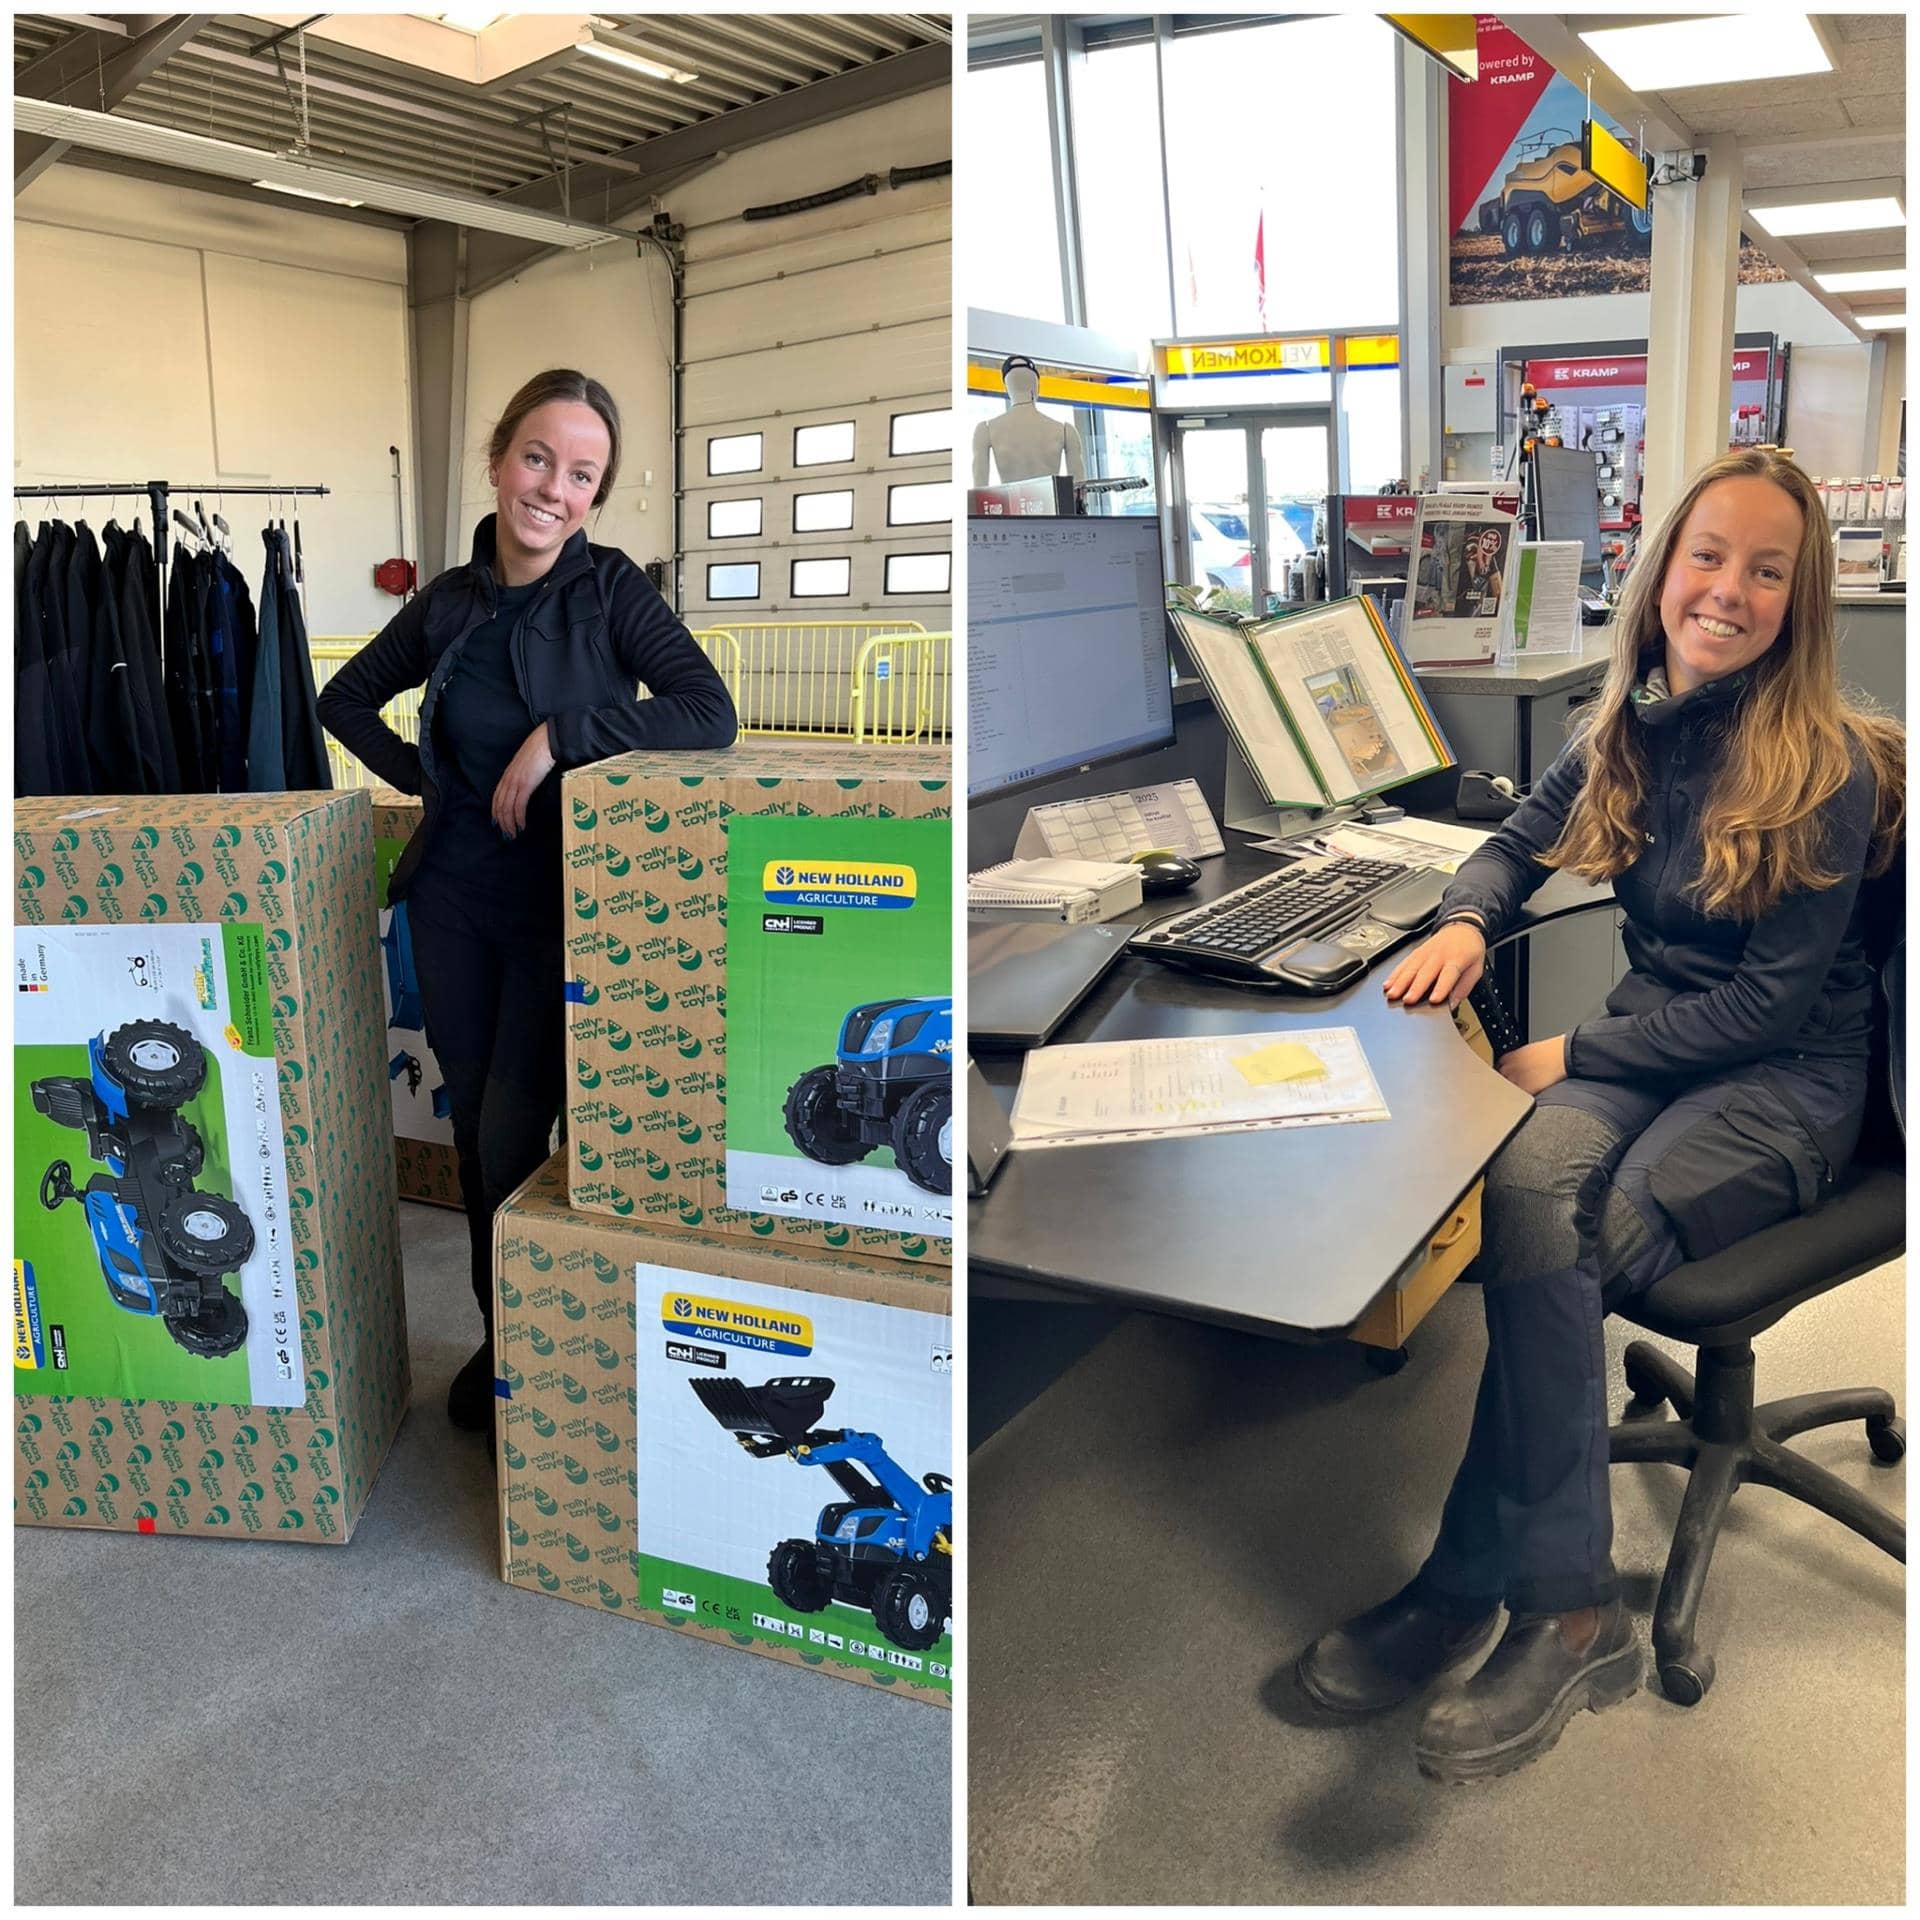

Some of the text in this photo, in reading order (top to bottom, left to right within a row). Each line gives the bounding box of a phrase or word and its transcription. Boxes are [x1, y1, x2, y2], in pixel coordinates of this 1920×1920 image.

[1479, 54, 1535, 71] owered by
[1490, 72, 1535, 85] KRAMP
[1573, 367, 1618, 378] KRAMP
[1136, 792, 1159, 803] 2025
[609, 809, 643, 825] toys
[681, 809, 718, 827] toys
[571, 852, 605, 869] toys
[642, 855, 676, 871] toys
[798, 872, 904, 888] NEW HOLLAND
[609, 898, 643, 915] toys
[796, 893, 878, 906] AGRICULTURE
[681, 901, 716, 920] toys
[765, 917, 790, 929] CNH
[573, 940, 606, 956] toys
[642, 945, 676, 961] toys
[18, 958, 27, 982] made
[37, 944, 48, 982] Germany
[31, 973, 37, 982] in
[611, 987, 644, 1002] toys
[680, 992, 716, 1009] toys
[244, 990, 252, 1024] Schneider
[575, 1026, 606, 1041] toys
[643, 1033, 676, 1048] toys
[612, 1072, 644, 1087] toys
[681, 1080, 715, 1095] toys
[576, 1109, 608, 1124] toys
[643, 1118, 677, 1132] toys
[614, 1155, 645, 1169] toys
[681, 1165, 715, 1179] toys
[578, 1191, 610, 1204] toys
[805, 1192, 825, 1207] CE
[645, 1200, 678, 1214] toys
[26, 1286, 41, 1344] AGRICULTURE
[695, 1306, 802, 1336] NEW HOLLAND
[16, 1319, 28, 1344] NEW
[694, 1327, 776, 1351] AGRICULTURE
